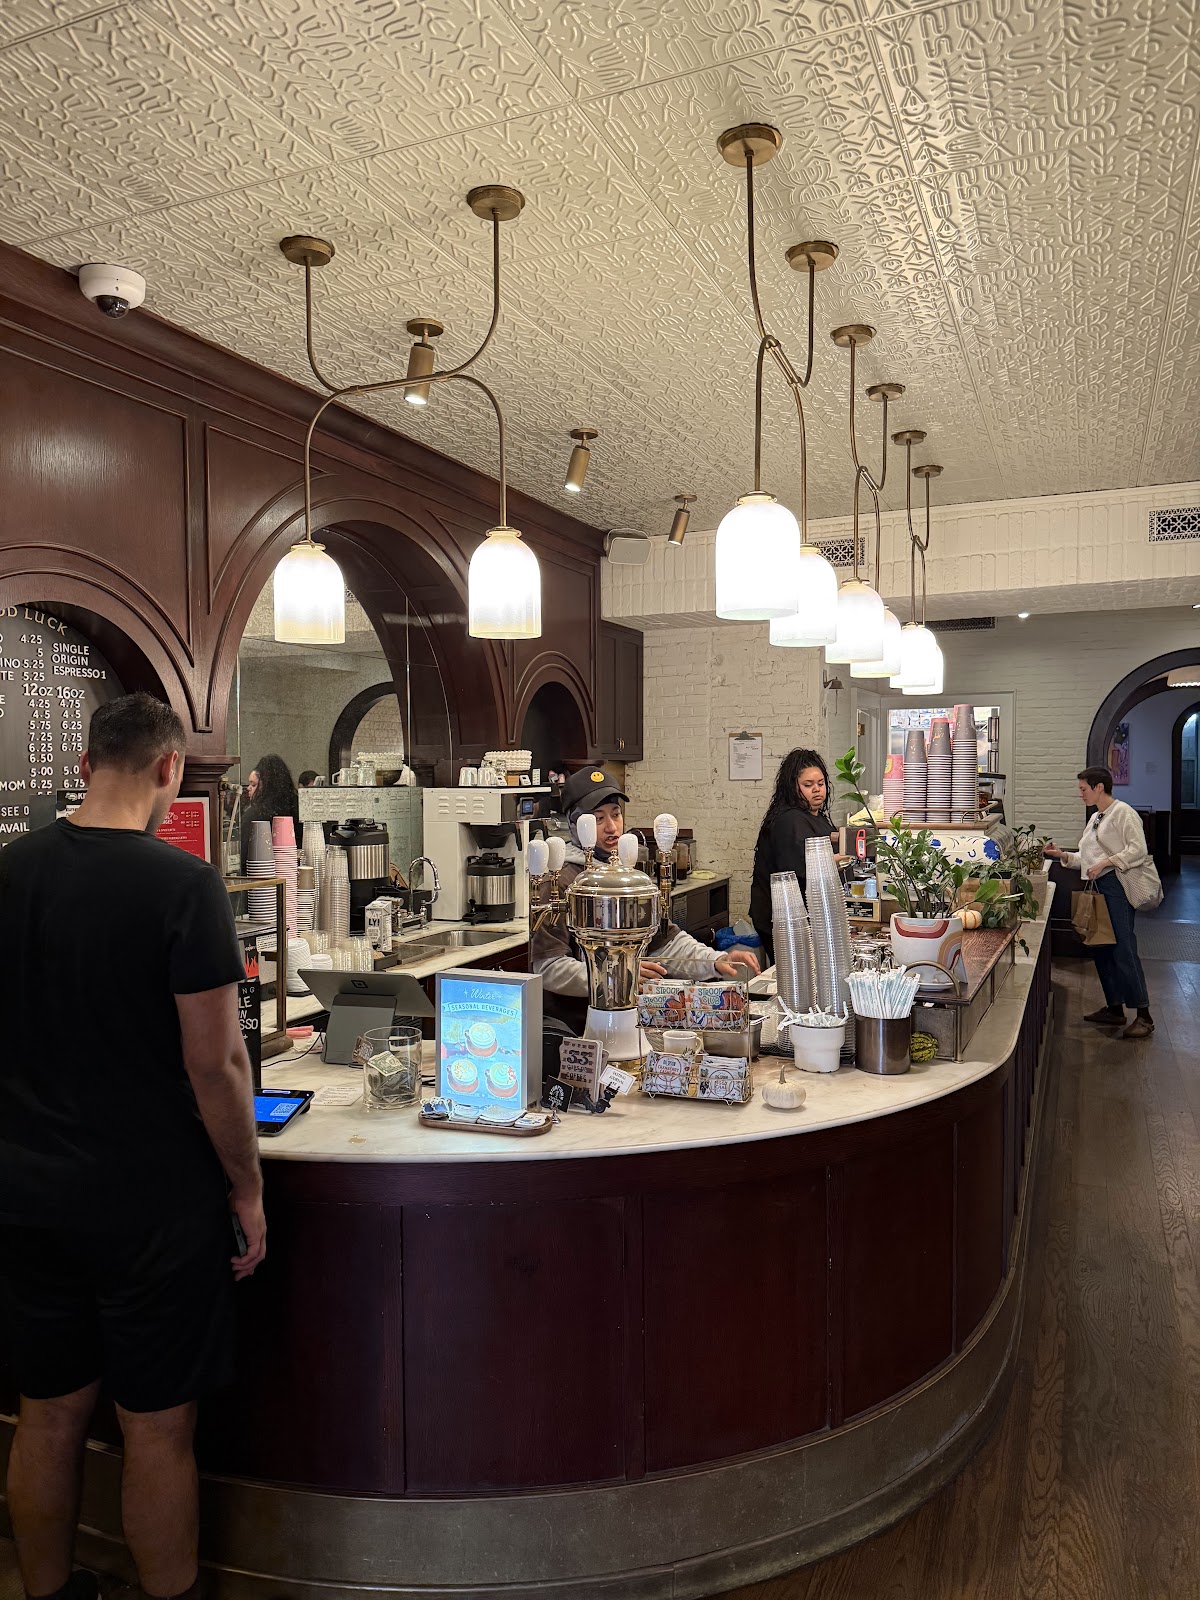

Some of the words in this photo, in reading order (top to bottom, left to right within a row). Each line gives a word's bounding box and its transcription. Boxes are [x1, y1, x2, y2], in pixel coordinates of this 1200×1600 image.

[24, 607, 68, 636] LUCK
[20, 634, 43, 644] 4.25
[37, 648, 43, 657] 5
[52, 643, 90, 655] SINGLE
[23, 659, 45, 669] 5.25
[52, 654, 89, 666] ORIGIN
[23, 672, 45, 682] 5.25
[53, 666, 100, 679] ESPRESSO
[28, 699, 51, 709] 4.25
[59, 699, 81, 709] 4.75
[29, 720, 51, 730] 5.75
[62, 721, 82, 730] 6.25
[29, 732, 52, 742] 7.25
[61, 733, 82, 742] 7.75
[29, 743, 53, 753] 6.25
[61, 743, 82, 752] 6.75
[29, 753, 53, 763] 6.50
[30, 779, 53, 789] 6.25
[63, 779, 85, 789] 6.75
[1, 806, 20, 817] SEE
[368, 918, 380, 927] LY!
[451, 1003, 480, 1011] SEASONAL
[481, 1003, 515, 1017] BEVERAGES
[566, 1049, 590, 1066] 33
